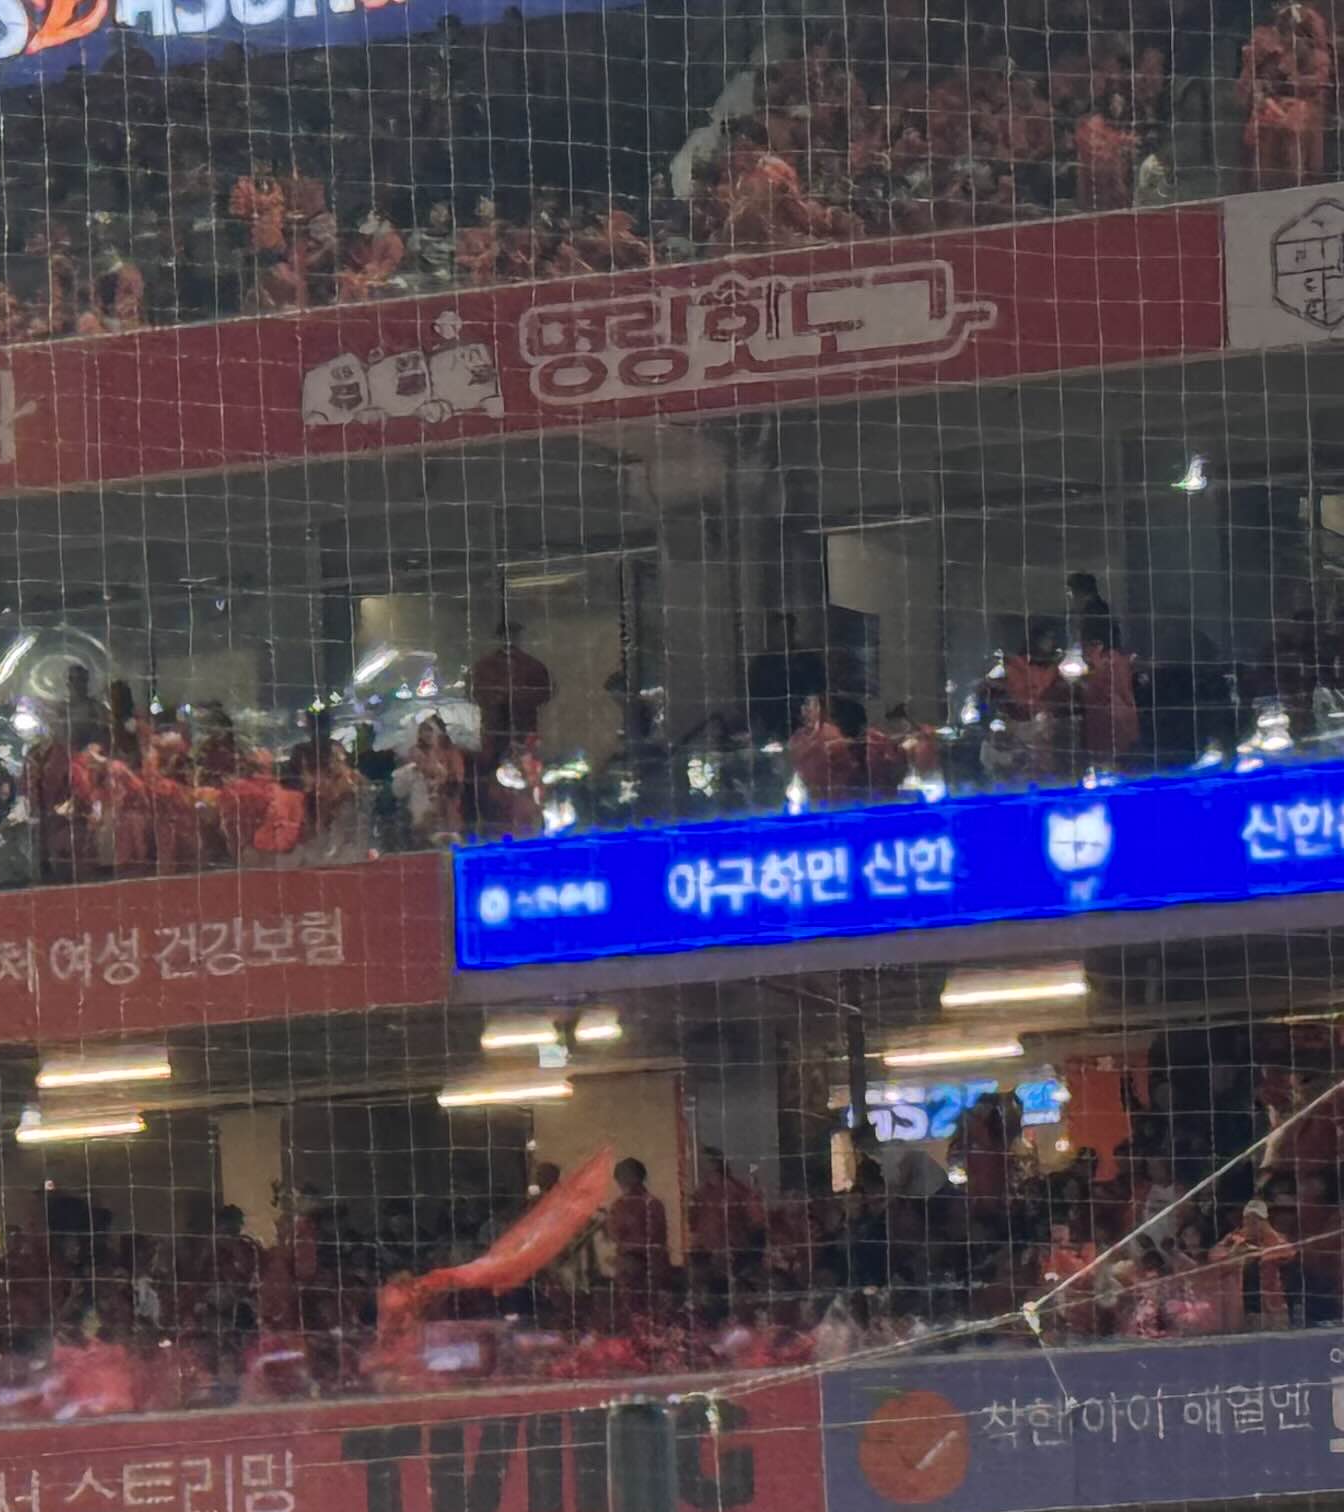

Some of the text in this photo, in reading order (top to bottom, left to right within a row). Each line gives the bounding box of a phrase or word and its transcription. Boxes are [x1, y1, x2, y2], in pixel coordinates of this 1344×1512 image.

[1241, 797, 1344, 861] 신한
[50, 926, 142, 990] 여성
[154, 908, 345, 978] 건강보험
